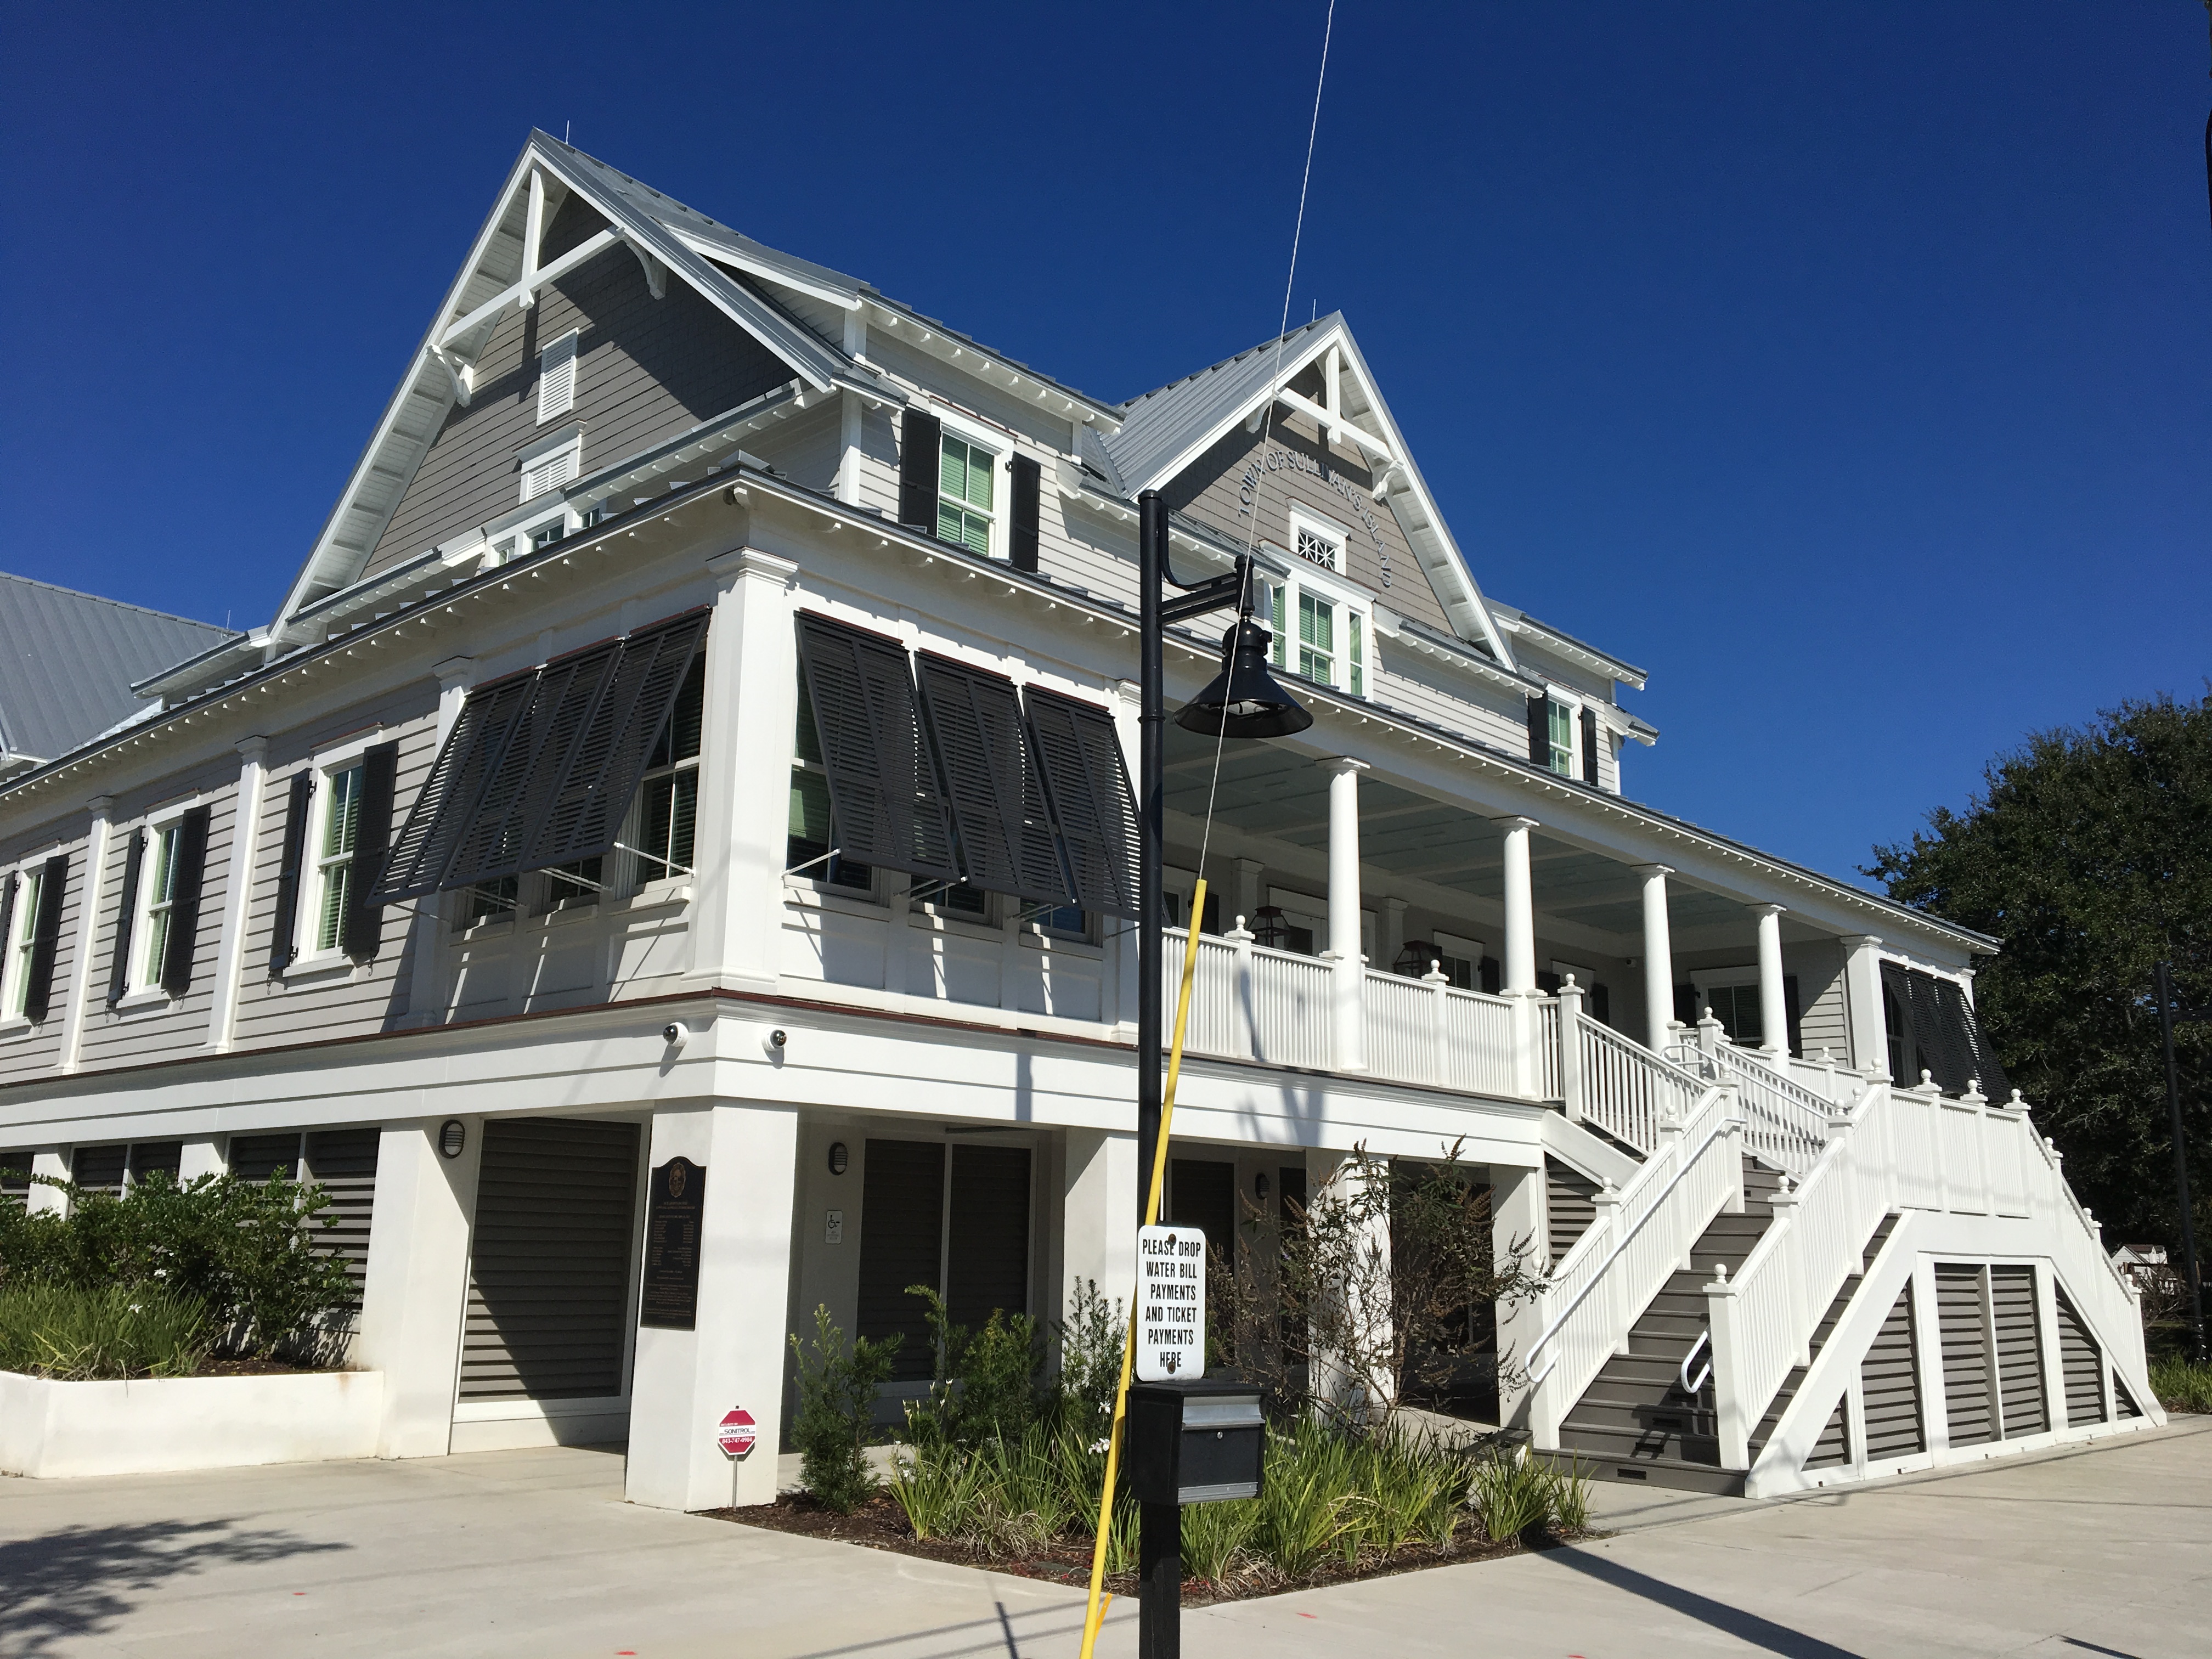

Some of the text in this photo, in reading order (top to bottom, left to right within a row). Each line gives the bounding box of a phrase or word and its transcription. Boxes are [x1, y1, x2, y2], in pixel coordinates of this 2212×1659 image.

[1238, 450, 1391, 588] TOWN OF SULLIVAN'S ISLAND
[1143, 1239, 1201, 1257] PLEASE DROP
[1146, 1261, 1197, 1279] WATER BILL
[1150, 1284, 1196, 1300] PAYMENTS
[1145, 1306, 1197, 1323] AND TICKET
[1148, 1329, 1193, 1345] PAYMENTS
[1160, 1352, 1181, 1367] HERE
